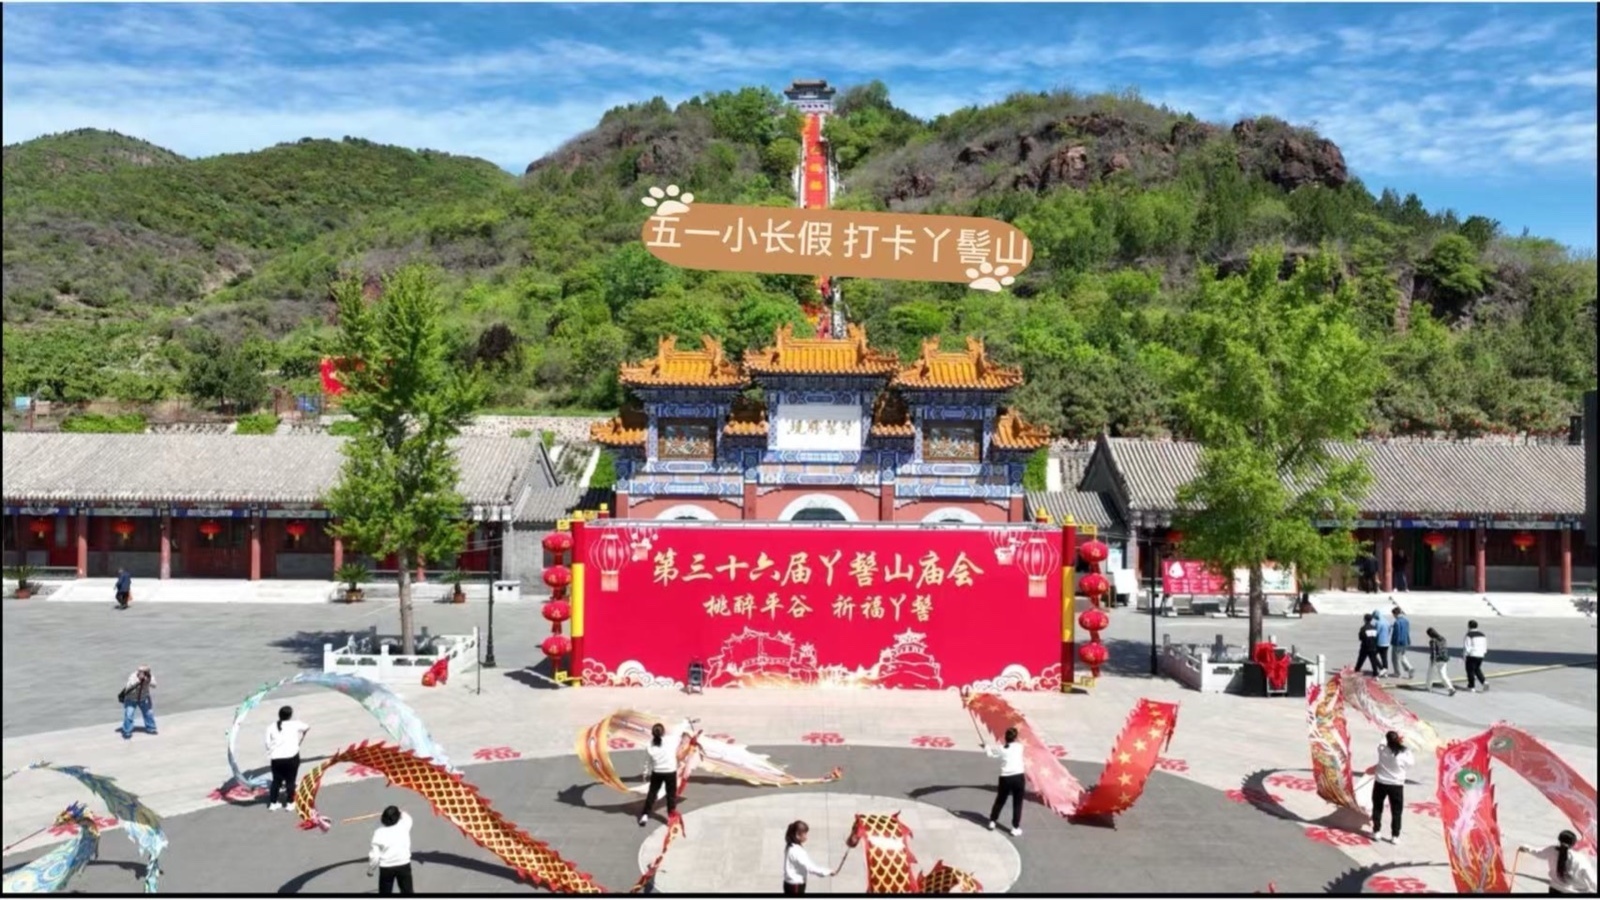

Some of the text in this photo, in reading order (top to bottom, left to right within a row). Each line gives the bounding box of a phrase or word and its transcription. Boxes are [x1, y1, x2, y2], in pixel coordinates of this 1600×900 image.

[653, 547, 984, 589] 第三十六届丫髻山庙会
[702, 592, 934, 622] 桃醉平谷 祈福丫髻
